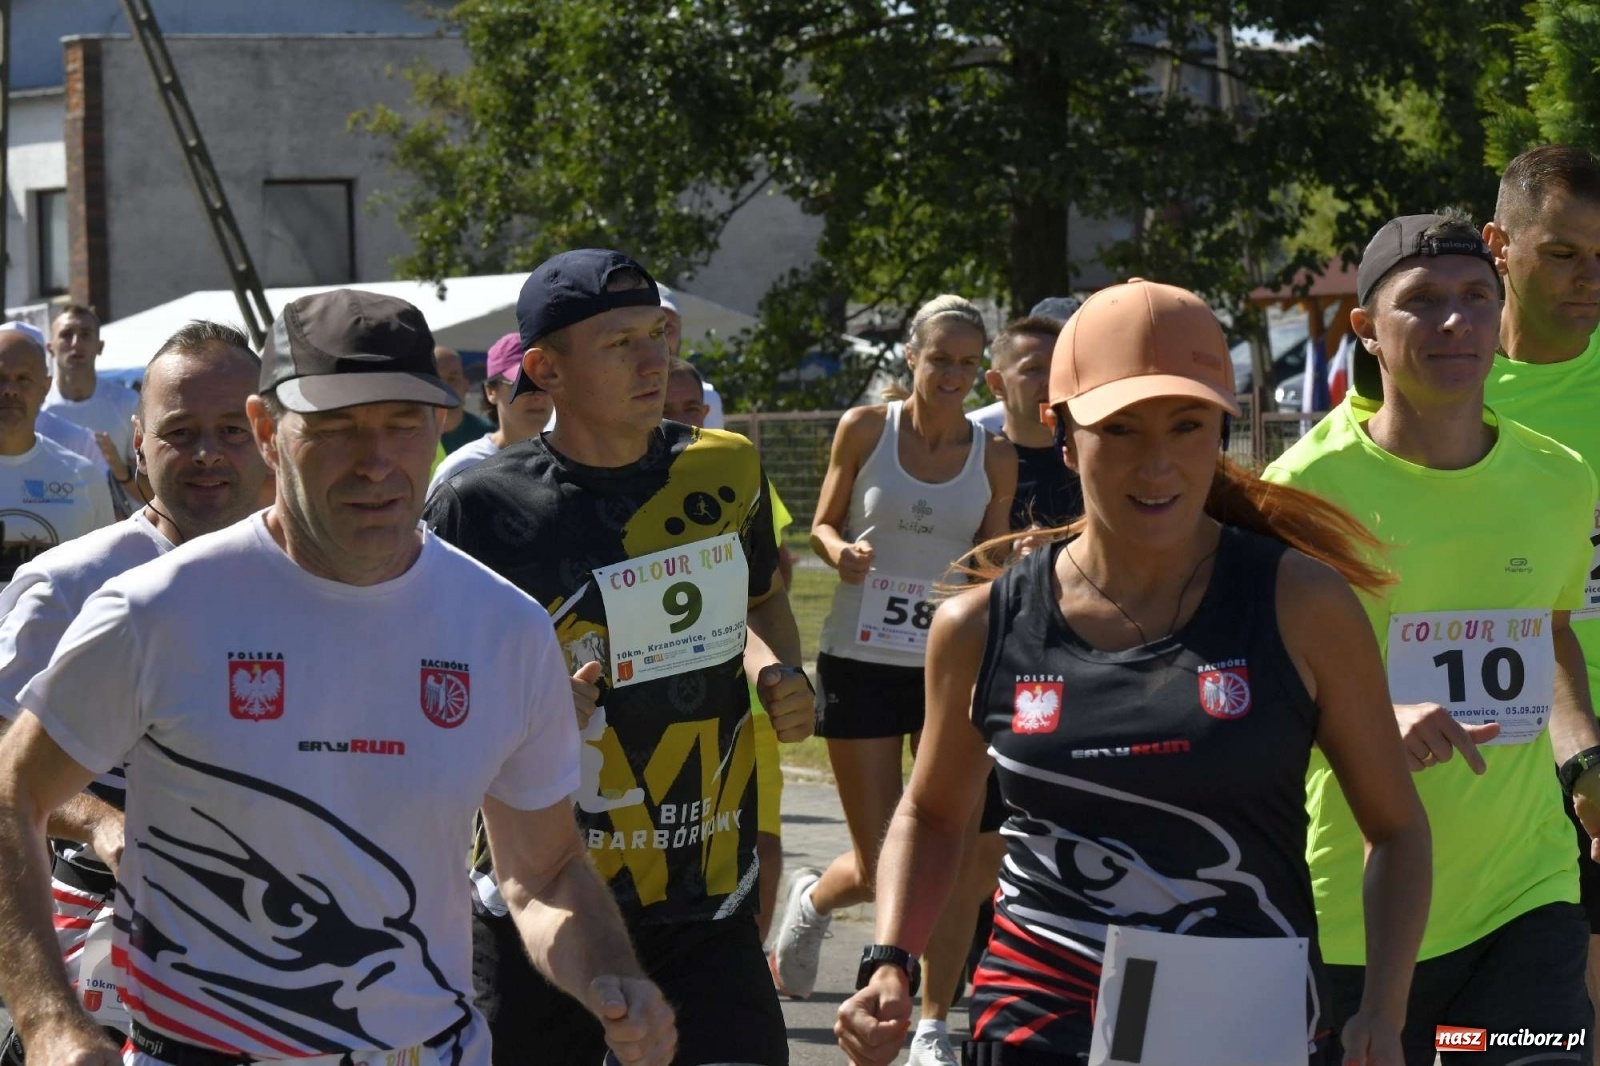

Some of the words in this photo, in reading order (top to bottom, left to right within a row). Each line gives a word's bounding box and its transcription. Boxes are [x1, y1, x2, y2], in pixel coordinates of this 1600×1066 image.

[609, 554, 692, 590] COLOUR
[699, 542, 734, 570] RUN
[871, 578, 925, 597] COLOUR
[662, 581, 703, 634] 9
[883, 596, 936, 630] 58
[1401, 619, 1495, 643] COLOUR
[1507, 618, 1542, 642] RUN
[227, 651, 284, 660] POLSKA
[616, 648, 645, 660] 10km,
[647, 634, 706, 653] Krzanowice,
[420, 658, 470, 672] RACIBÓRZ
[1197, 658, 1248, 673] RACIBÓRZ
[1432, 646, 1525, 703] 10
[1015, 674, 1064, 683] POLSKA
[1449, 707, 1499, 717] zanowice,
[1505, 705, 1549, 715] 05.09.2021
[660, 797, 712, 824] BIEG
[587, 808, 742, 850] BARBÓRKOWY
